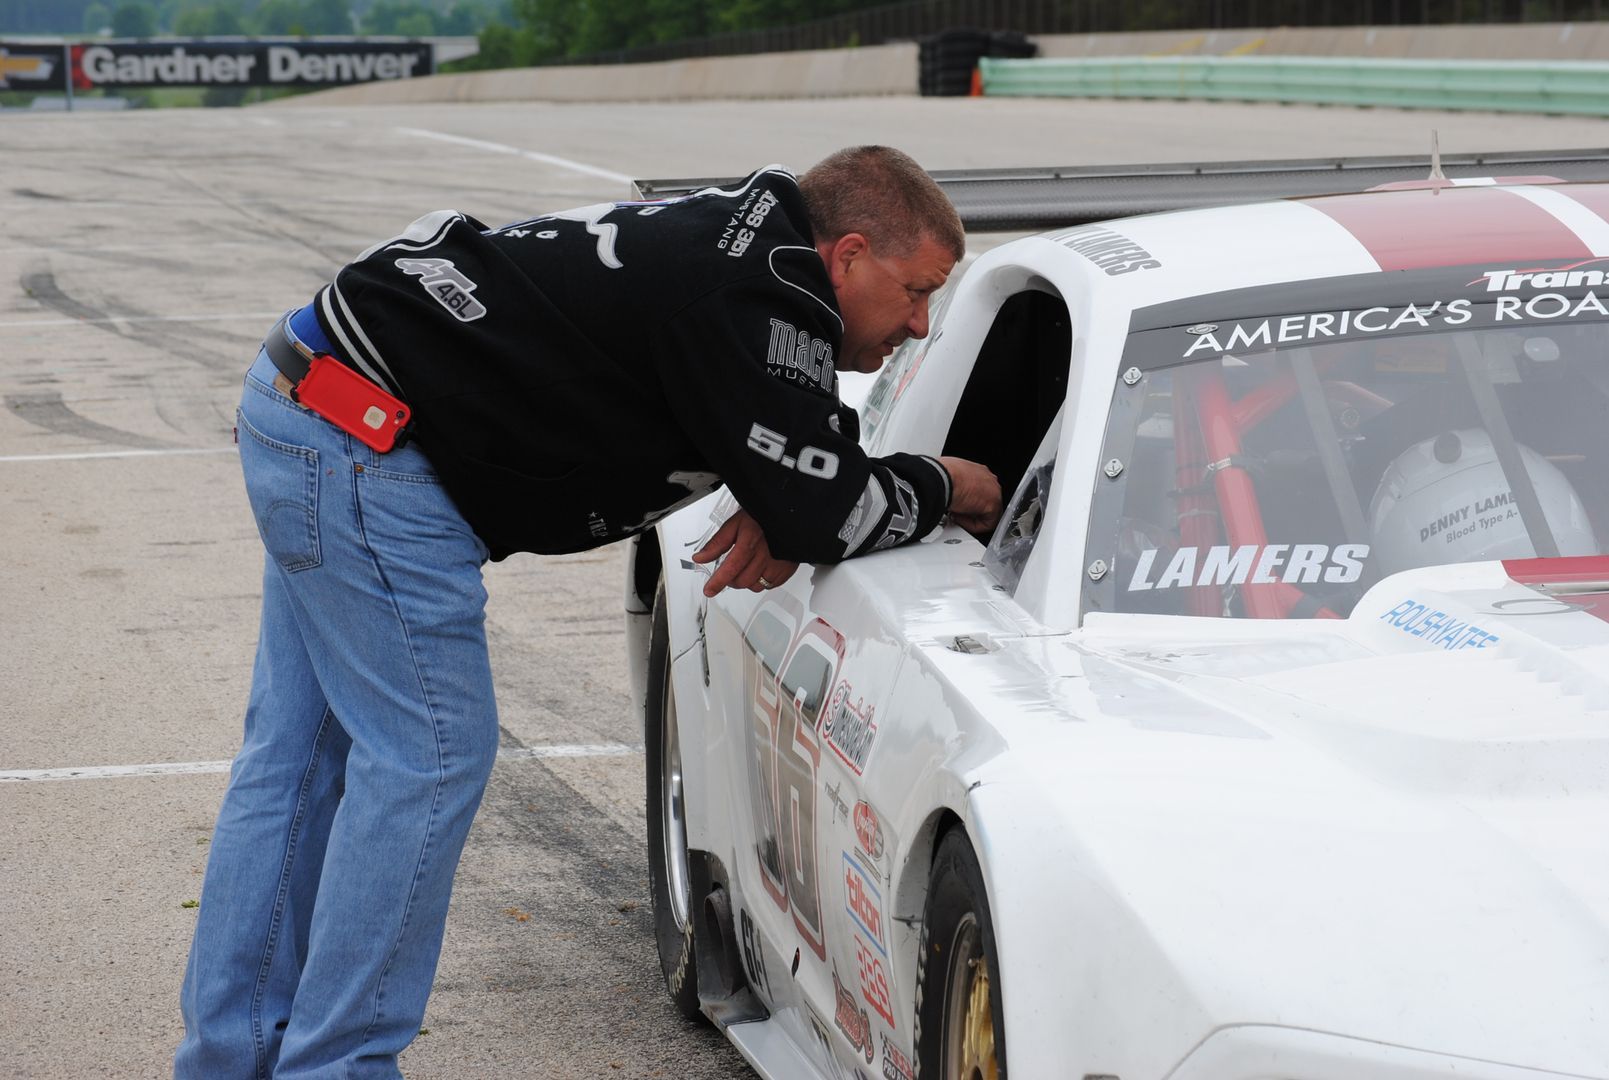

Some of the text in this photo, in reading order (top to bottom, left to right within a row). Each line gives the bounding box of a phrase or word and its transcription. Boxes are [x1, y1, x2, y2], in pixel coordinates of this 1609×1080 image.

[82, 45, 417, 83] Gardner Denver
[717, 188, 761, 249] MUSTANG
[436, 282, 468, 318] 4.6L
[1182, 290, 1609, 358] AMERICA'S ROA
[747, 422, 840, 480] 5.0
[1420, 505, 1470, 543] DENNY
[1446, 521, 1476, 544] Blood
[1479, 513, 1503, 530] Type
[1128, 543, 1370, 592] LAMERS
